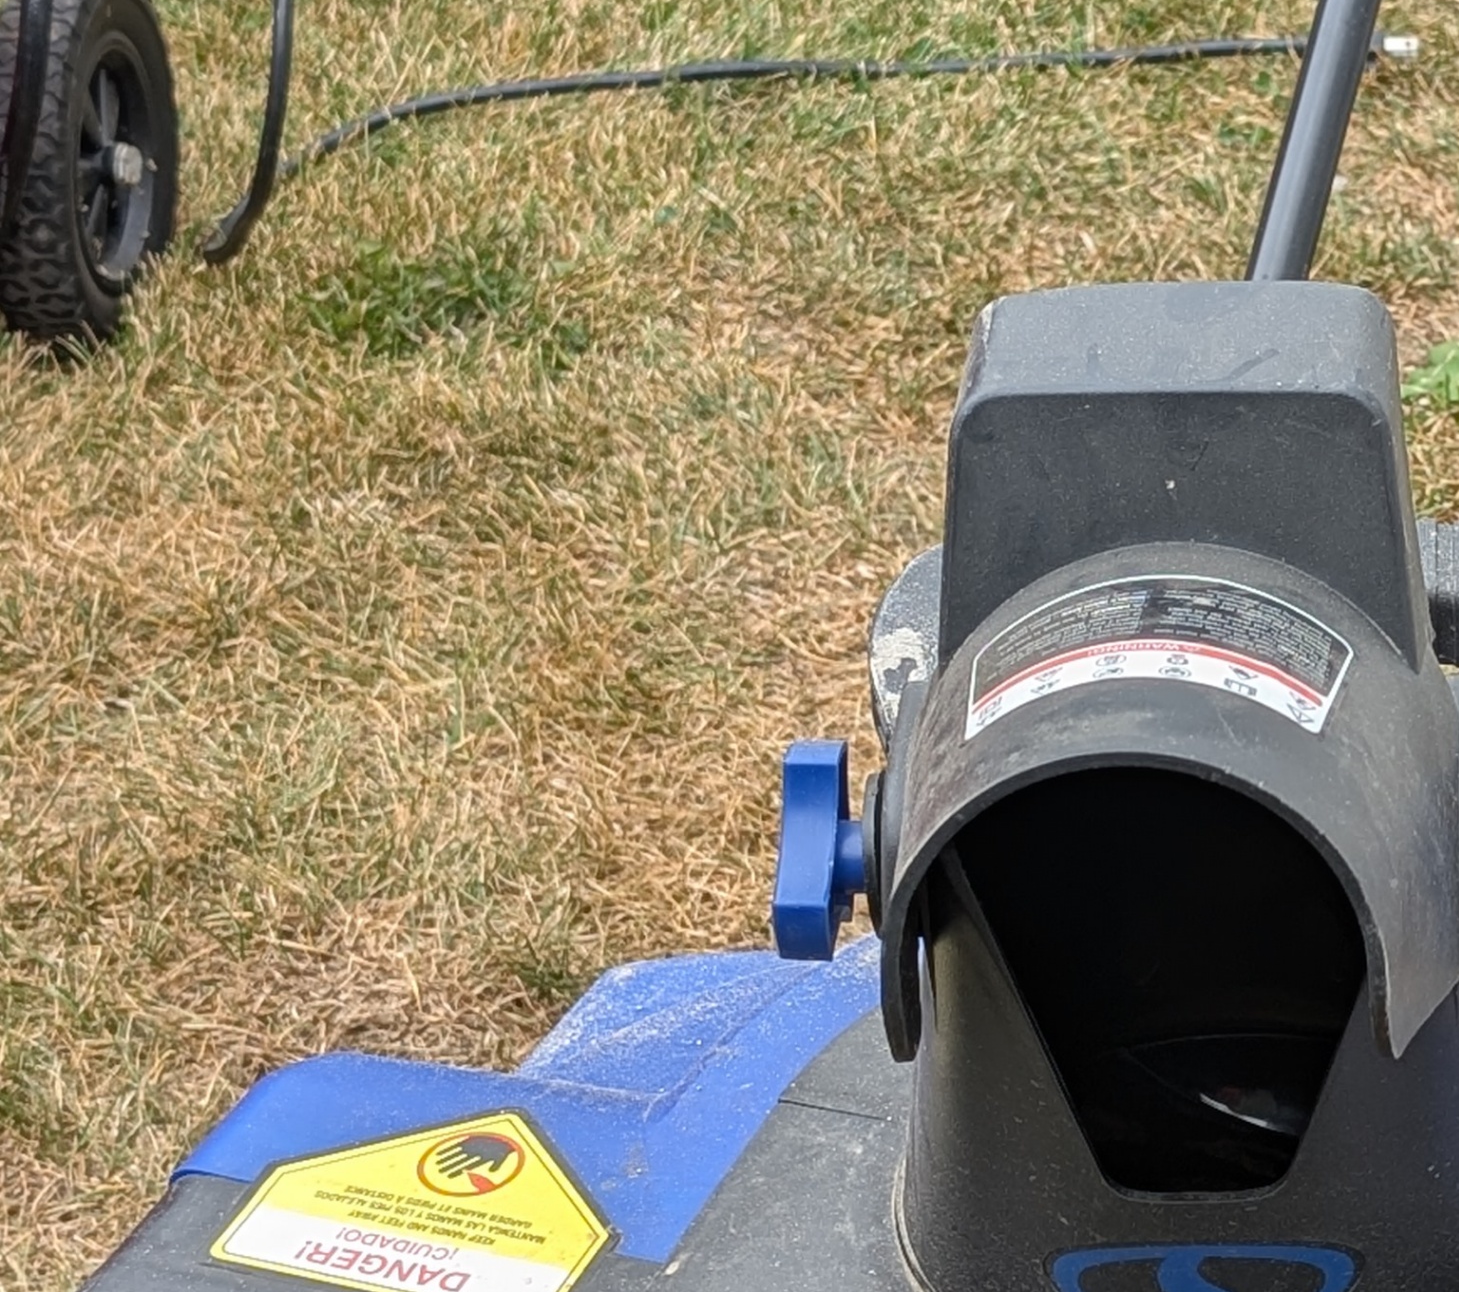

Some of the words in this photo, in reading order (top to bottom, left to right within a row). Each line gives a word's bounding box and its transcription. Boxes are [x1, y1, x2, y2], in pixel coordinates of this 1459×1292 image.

[347, 1209, 378, 1221] AWAY
[378, 1216, 404, 1226] FEET
[406, 1221, 428, 1231] AND
[431, 1226, 467, 1240] HANDS
[335, 1227, 459, 1260] ¡CUIDADO!
[468, 1234, 495, 1245] KEEP
[294, 1240, 471, 1292] DANGER!
